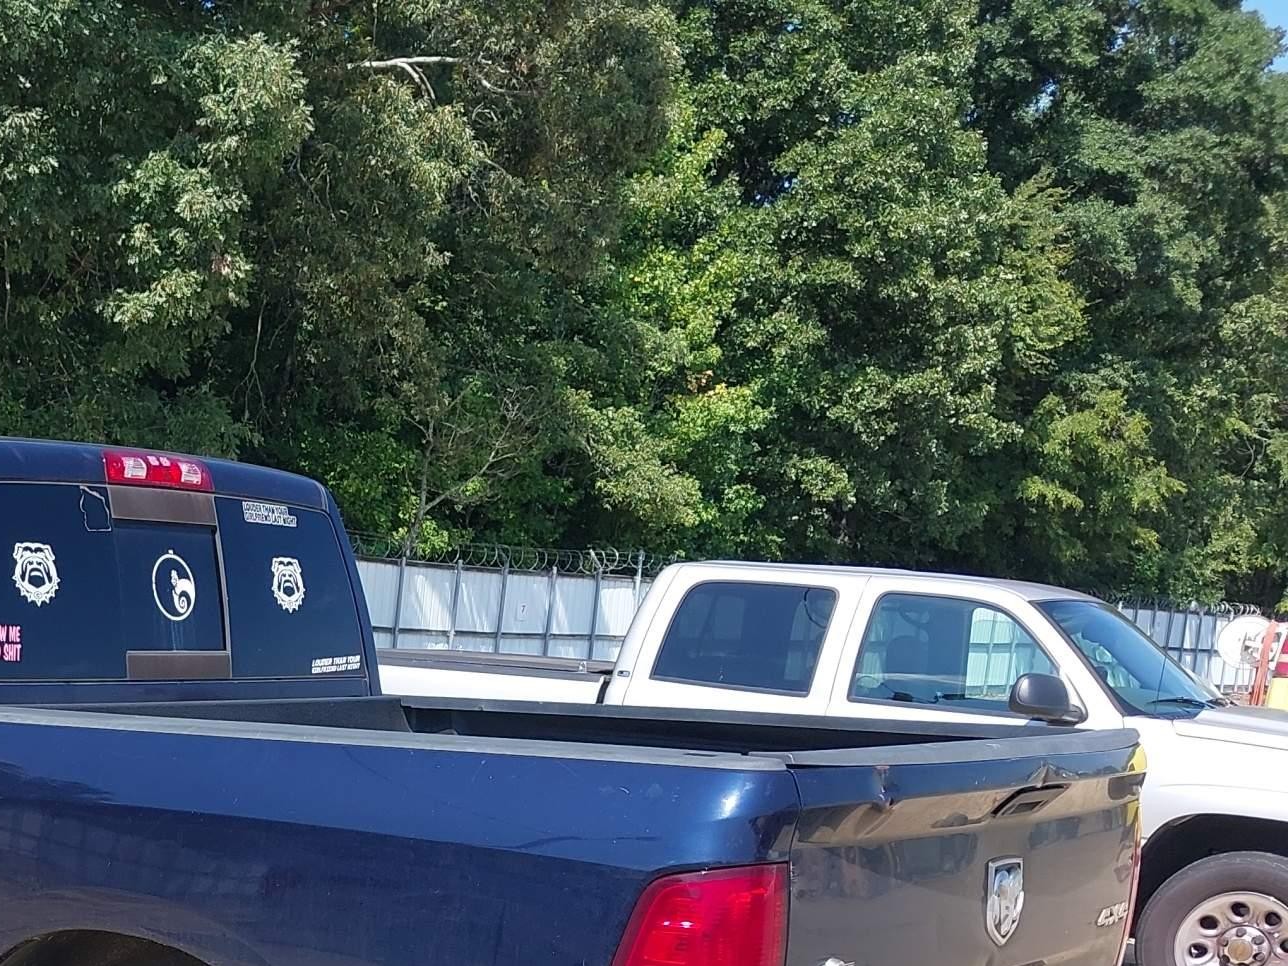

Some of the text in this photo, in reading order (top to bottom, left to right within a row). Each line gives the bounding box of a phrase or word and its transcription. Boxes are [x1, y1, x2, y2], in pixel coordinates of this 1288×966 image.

[243, 501, 262, 511] LOUDER
[244, 510, 272, 522] GIRLFRIEND
[283, 516, 297, 527] NIGHT
[9, 625, 21, 642] ME
[3, 643, 22, 661] SHIT
[312, 658, 332, 666] LOUDER
[347, 655, 360, 663] YOUR
